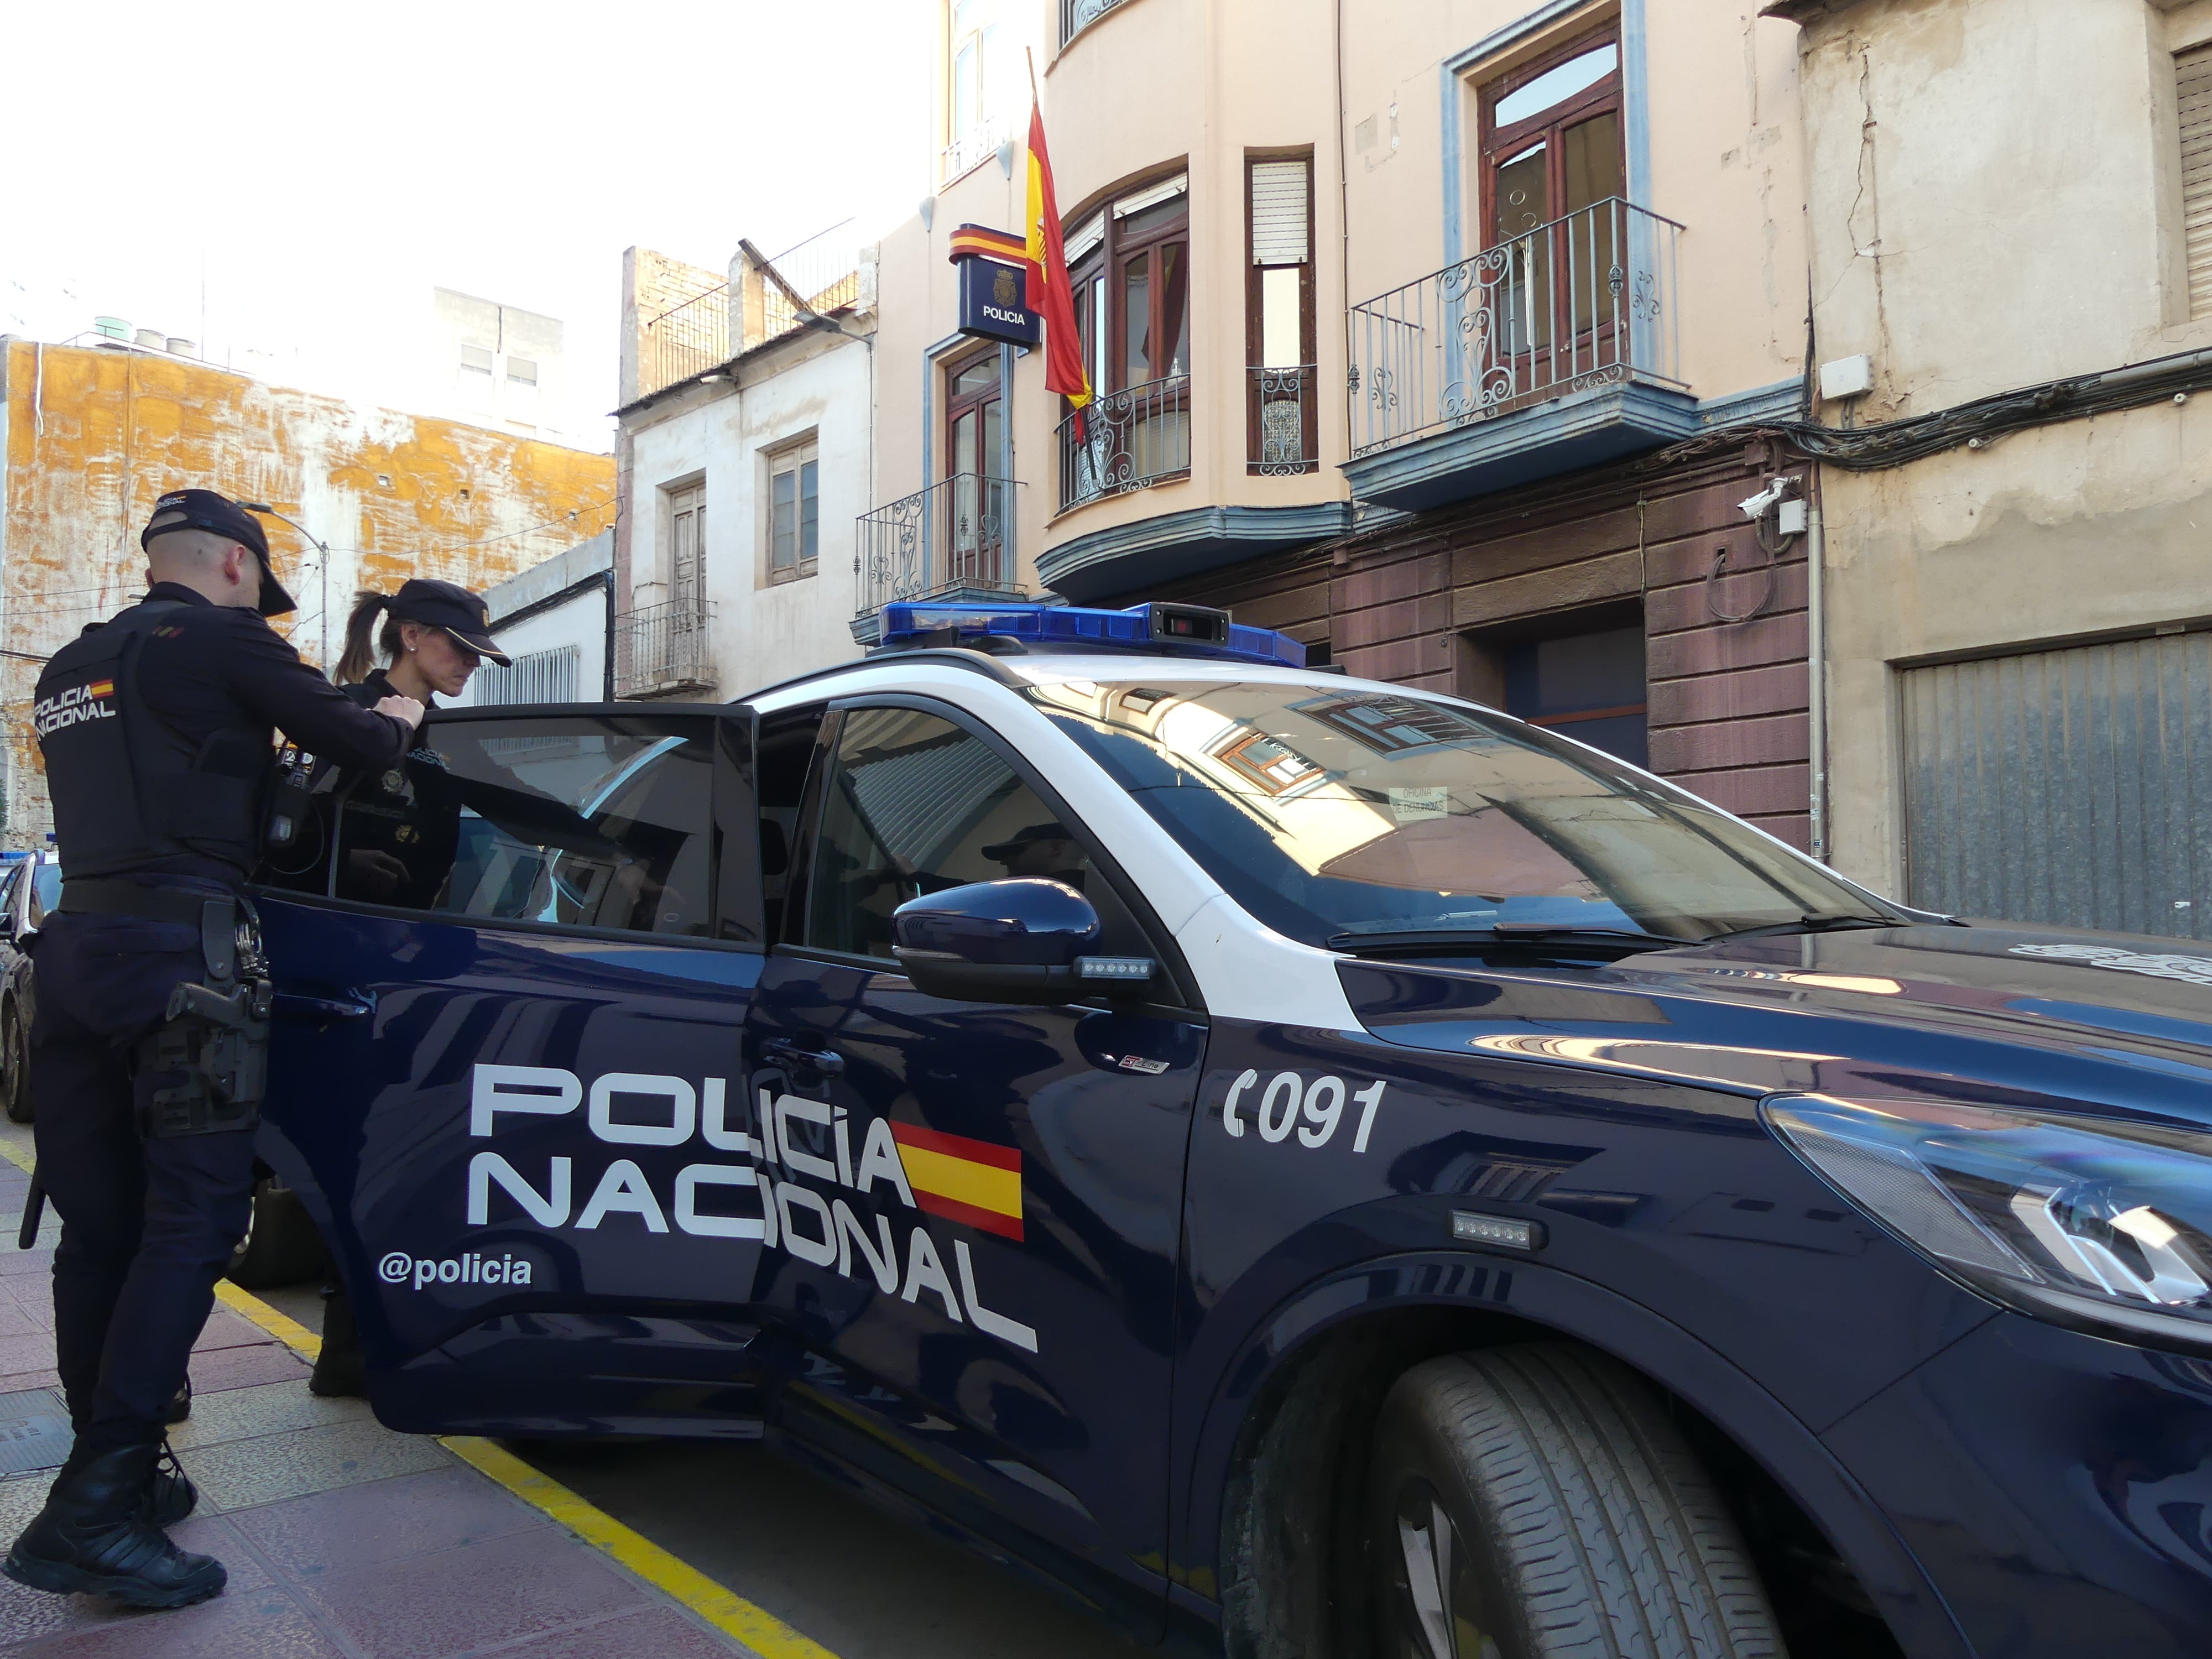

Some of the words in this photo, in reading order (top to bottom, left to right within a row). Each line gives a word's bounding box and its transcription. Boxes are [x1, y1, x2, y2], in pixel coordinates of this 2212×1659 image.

[984, 305, 1025, 325] POLICIA
[1403, 788, 1431, 798] OFICINA
[1259, 1072, 1386, 1152] 091
[378, 1251, 531, 1290] @policia
[467, 1152, 1039, 1353] NACIONAL
